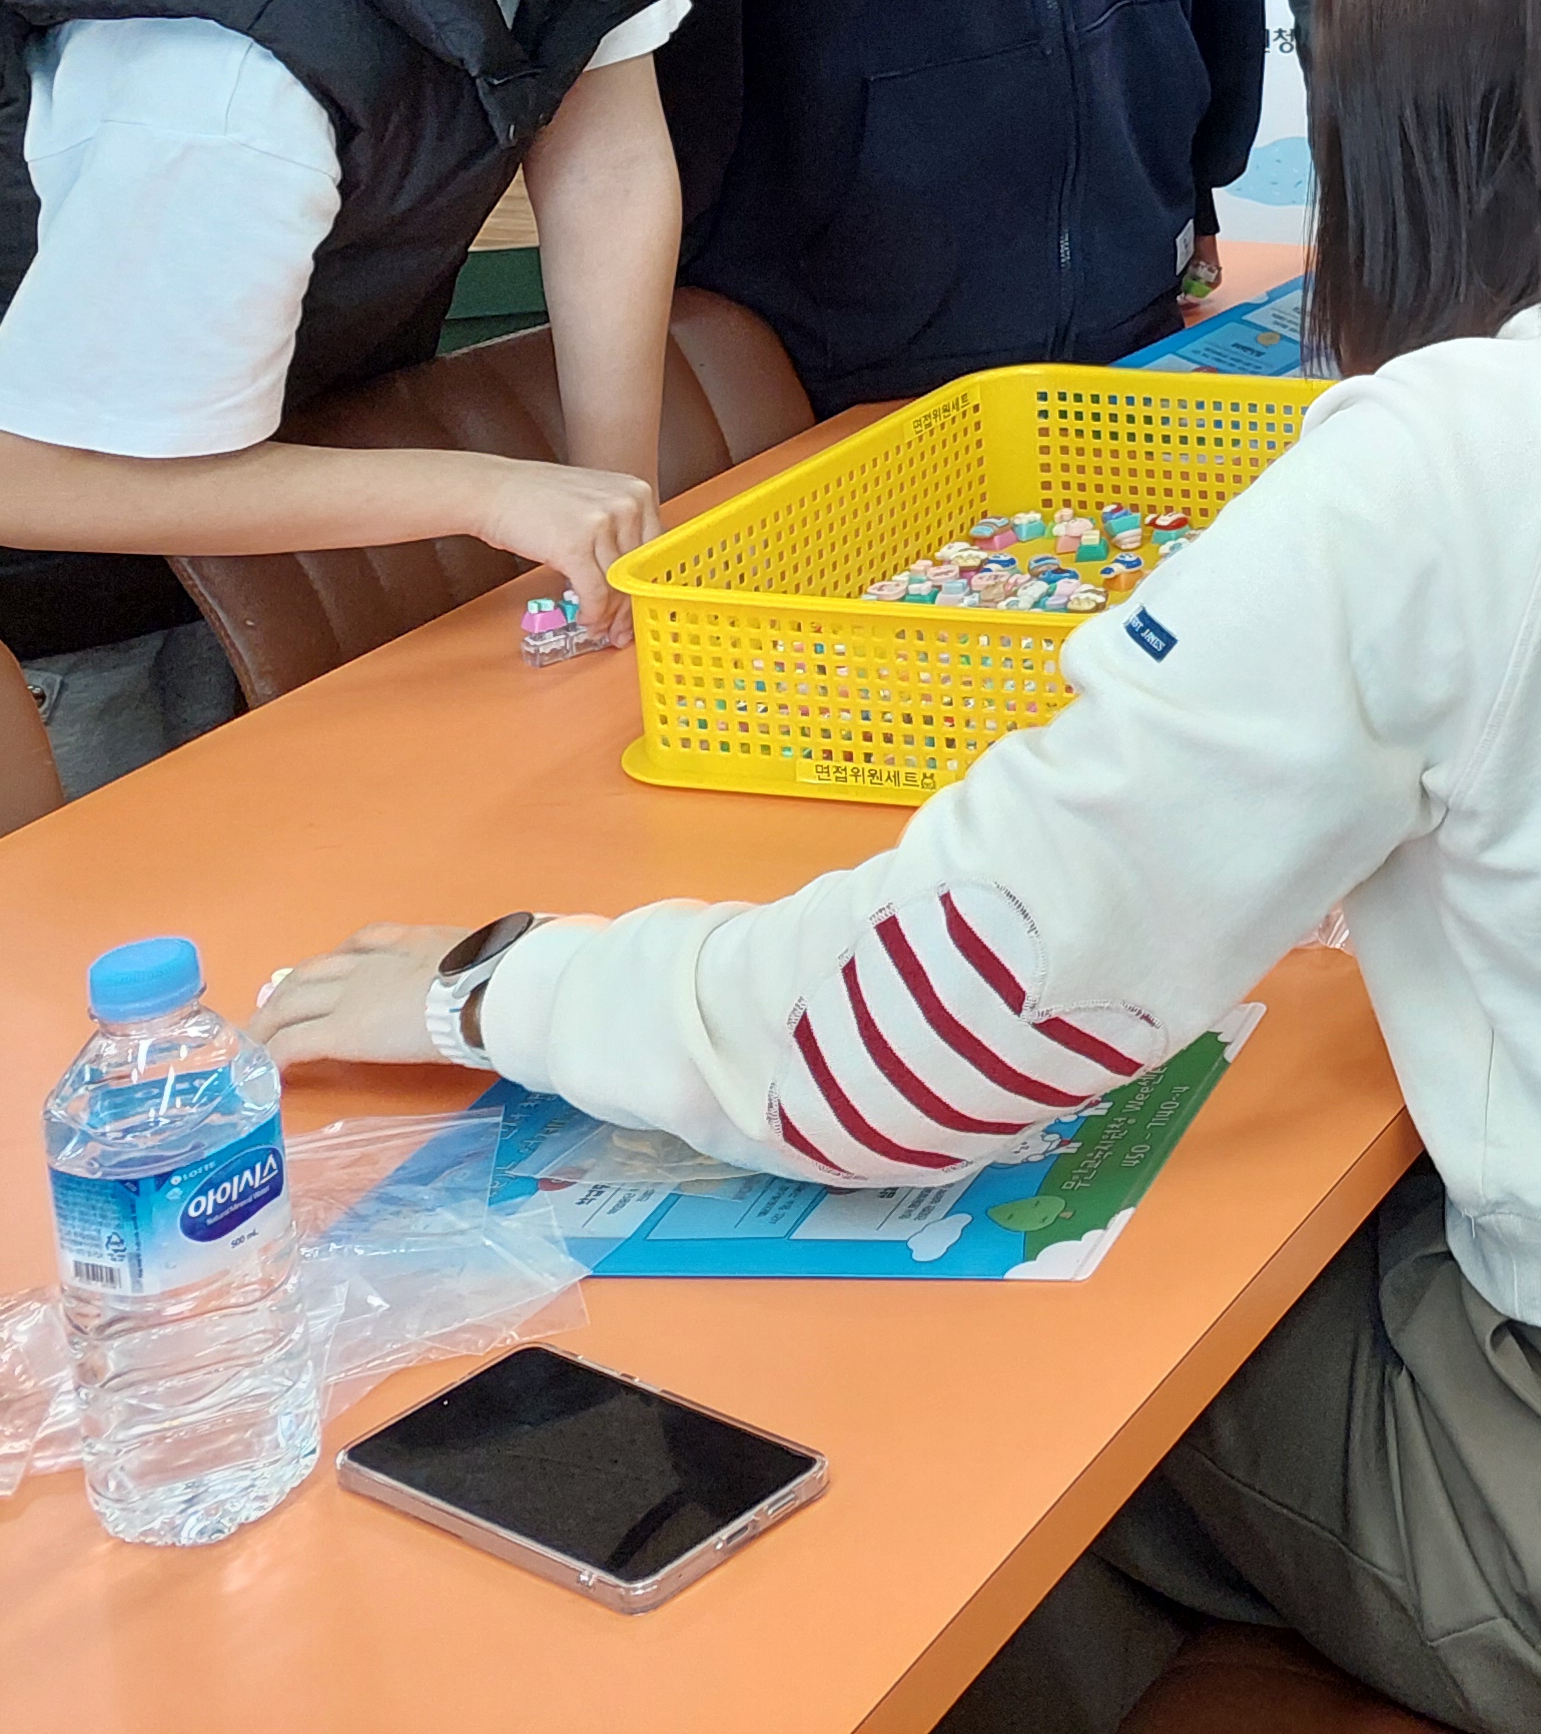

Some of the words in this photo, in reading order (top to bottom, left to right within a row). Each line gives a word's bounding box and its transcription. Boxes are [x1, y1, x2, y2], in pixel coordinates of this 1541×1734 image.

[912, 392, 971, 435] 면접위원세트
[814, 764, 920, 787] 면접위원세트
[1061, 1117, 1137, 1190] 무안교육지원청
[1120, 1145, 1151, 1167] 450
[182, 1161, 216, 1181] LOTTE
[188, 1154, 279, 1217] 아이시스
[231, 1234, 245, 1250] 500
